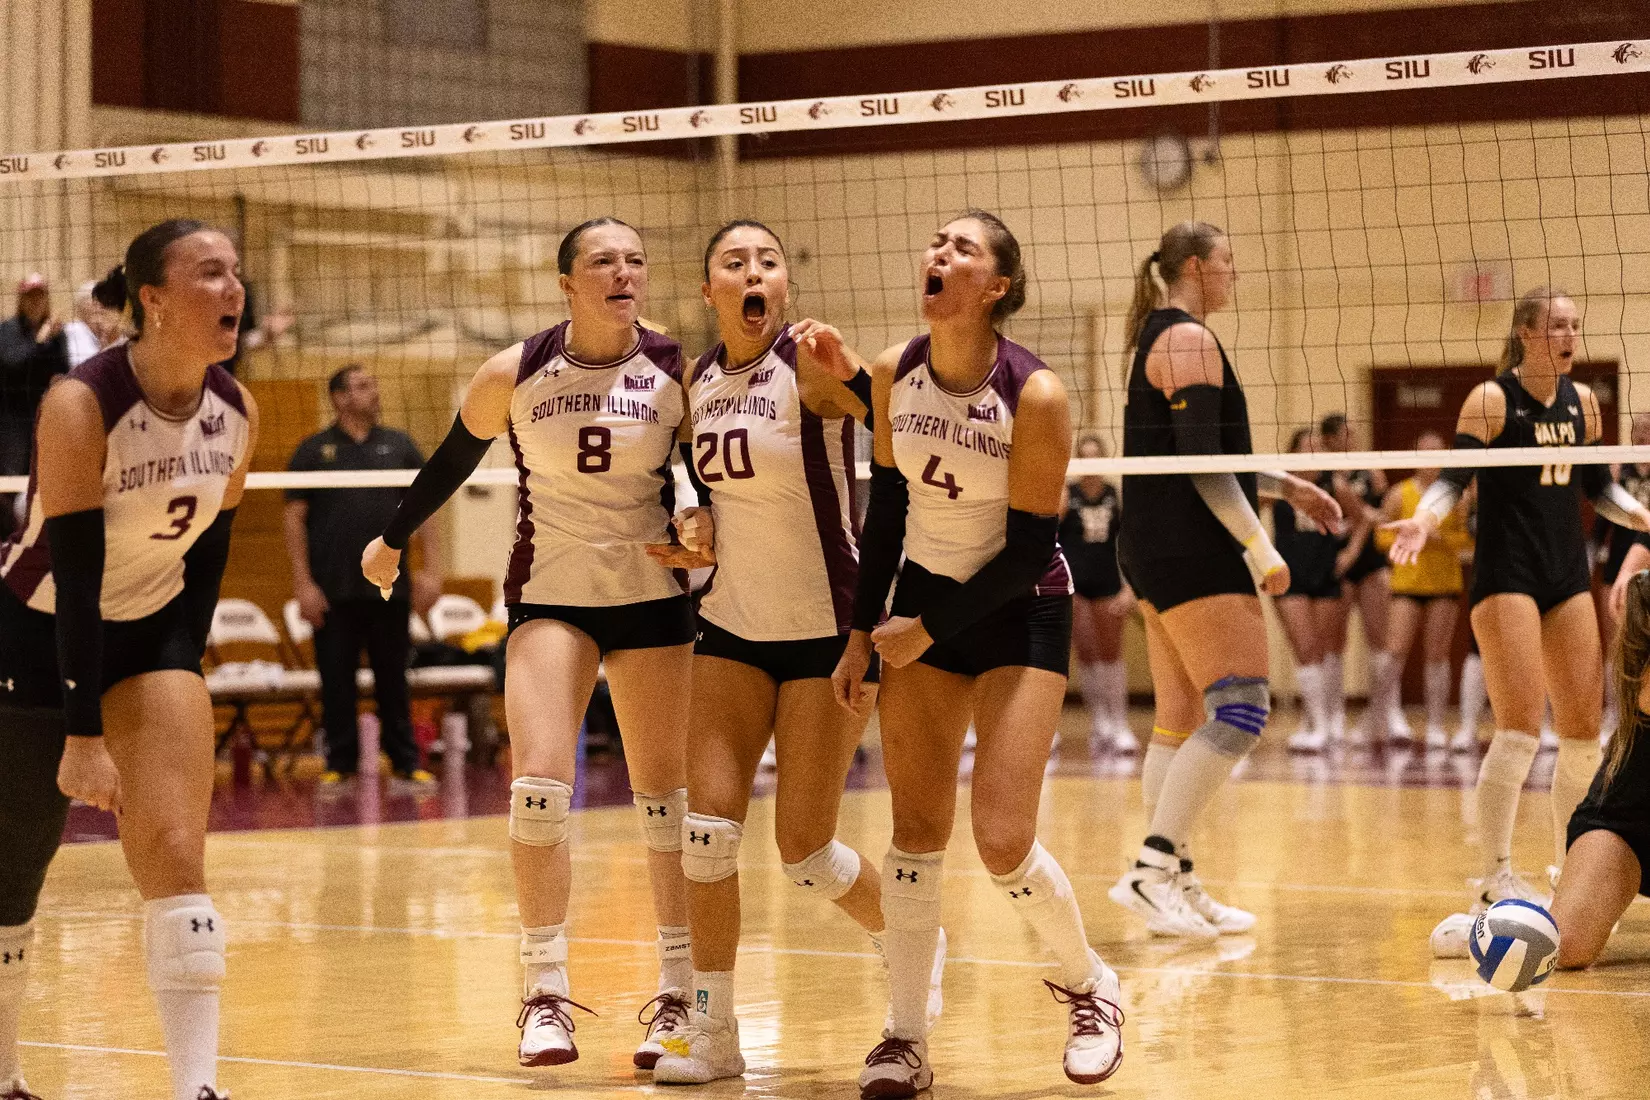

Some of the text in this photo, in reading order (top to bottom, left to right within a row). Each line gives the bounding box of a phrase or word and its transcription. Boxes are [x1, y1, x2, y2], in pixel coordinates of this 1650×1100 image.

[0, 49, 1575, 174] SIU SIU SIU SIU SIU SIU SIU SIU SIU SIU SIU SIU SIU SIU
[624, 374, 656, 389] VALLEY
[531, 393, 659, 424] SOUTHERN ILLINOIS
[733, 395, 777, 420] ILLINOIS
[577, 426, 612, 474] 8
[952, 423, 1012, 460] ILLINOIS
[1534, 421, 1576, 445] VALPO
[696, 428, 756, 483] 20
[921, 454, 964, 500] 4
[149, 496, 198, 540] 3
